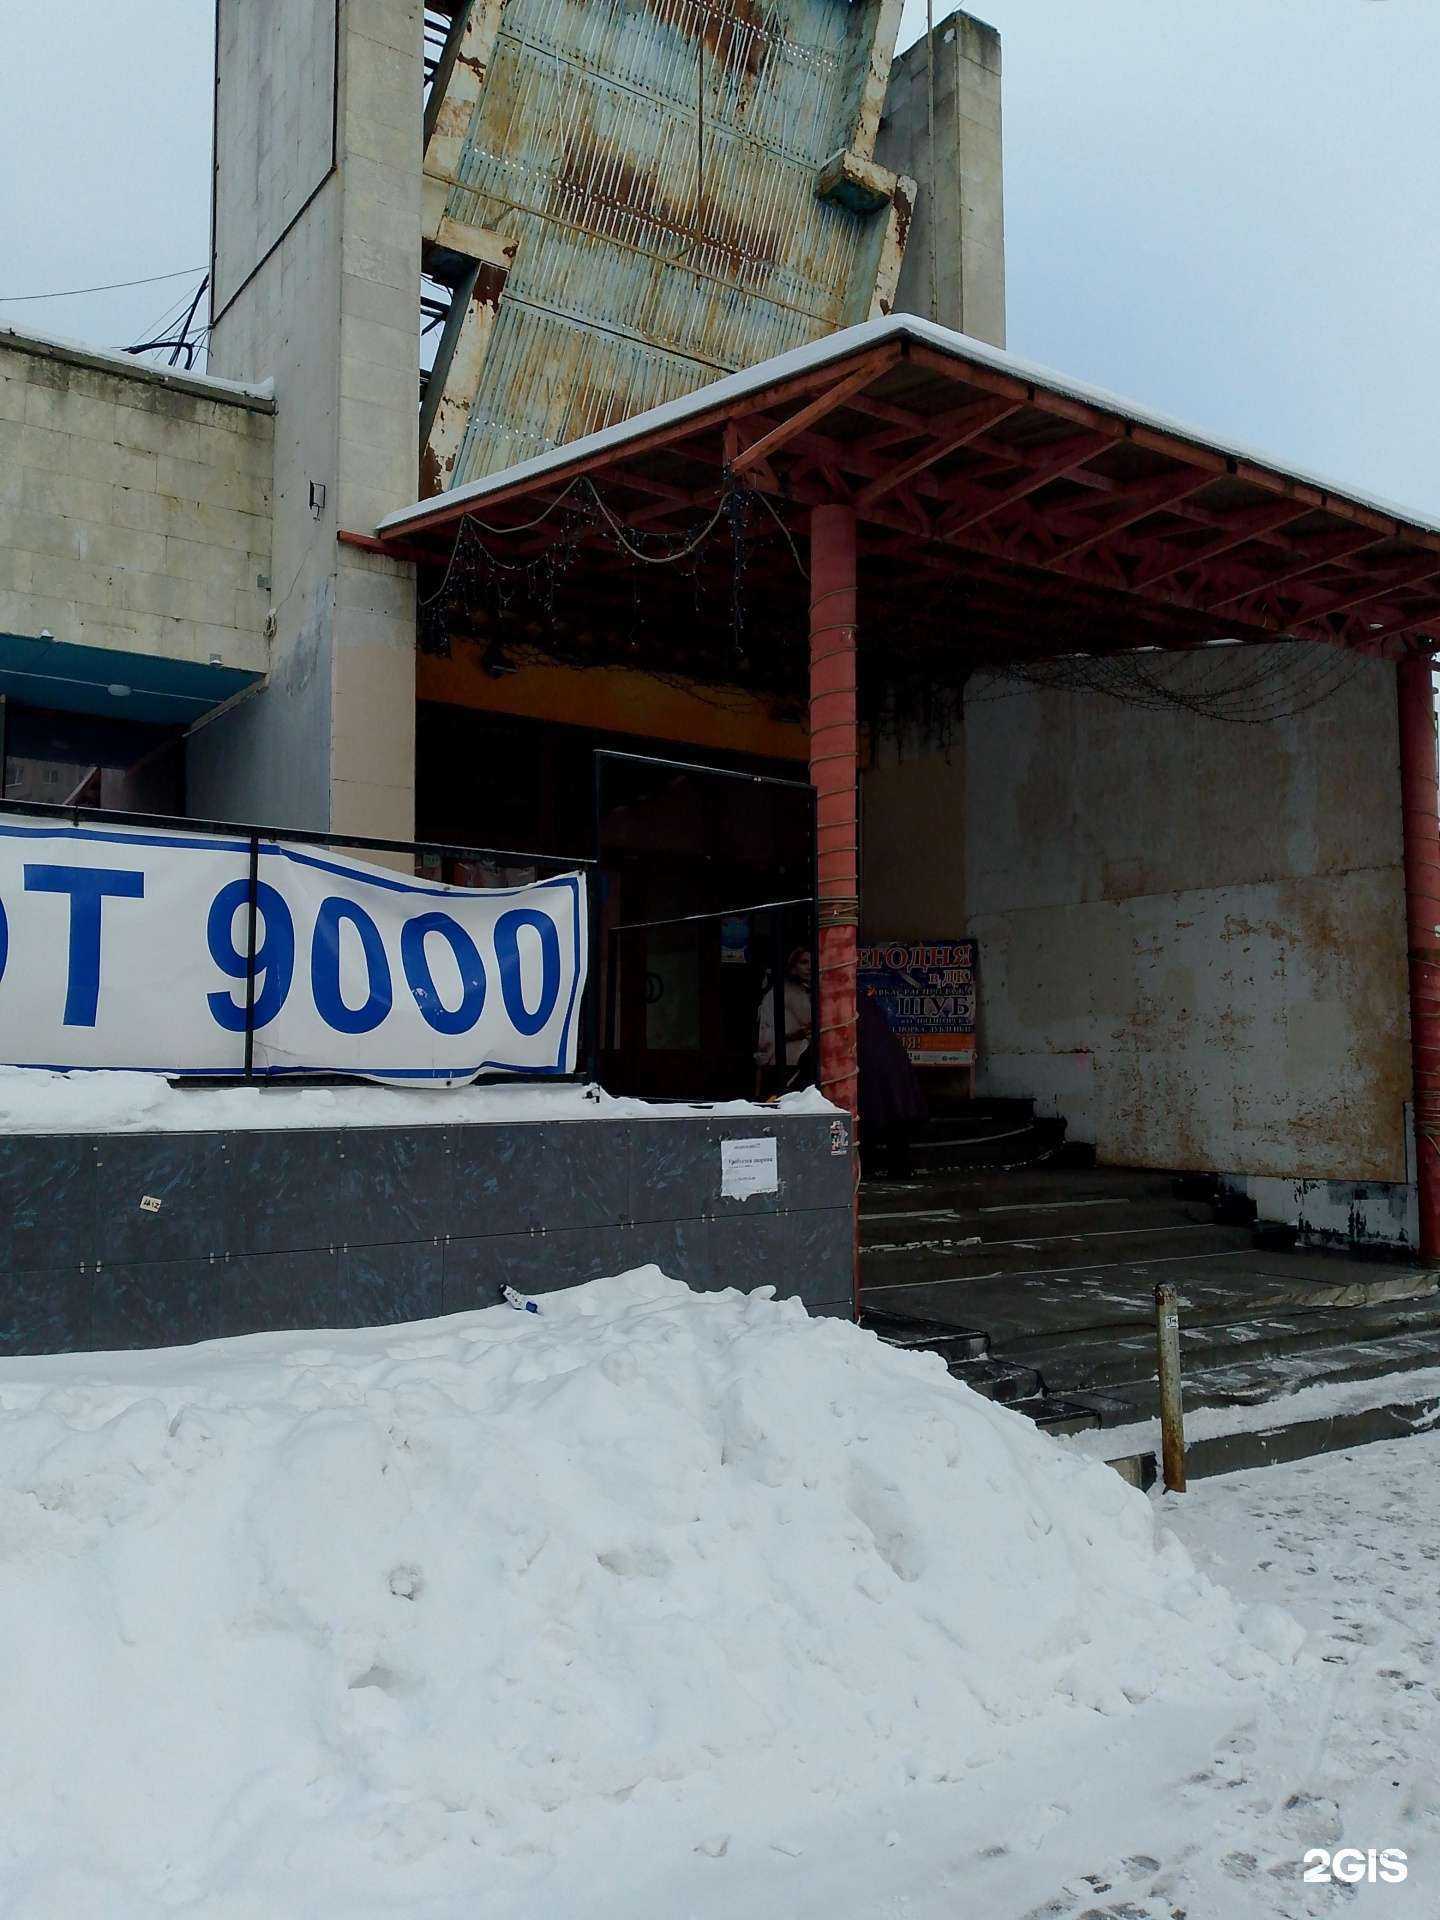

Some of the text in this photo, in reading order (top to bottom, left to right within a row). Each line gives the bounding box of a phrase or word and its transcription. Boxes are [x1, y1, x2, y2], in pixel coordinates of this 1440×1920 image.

[0, 863, 561, 1037] Т 9000
[857, 944, 973, 974] ЕГОДНЯ
[896, 996, 970, 1018] ШУБ
